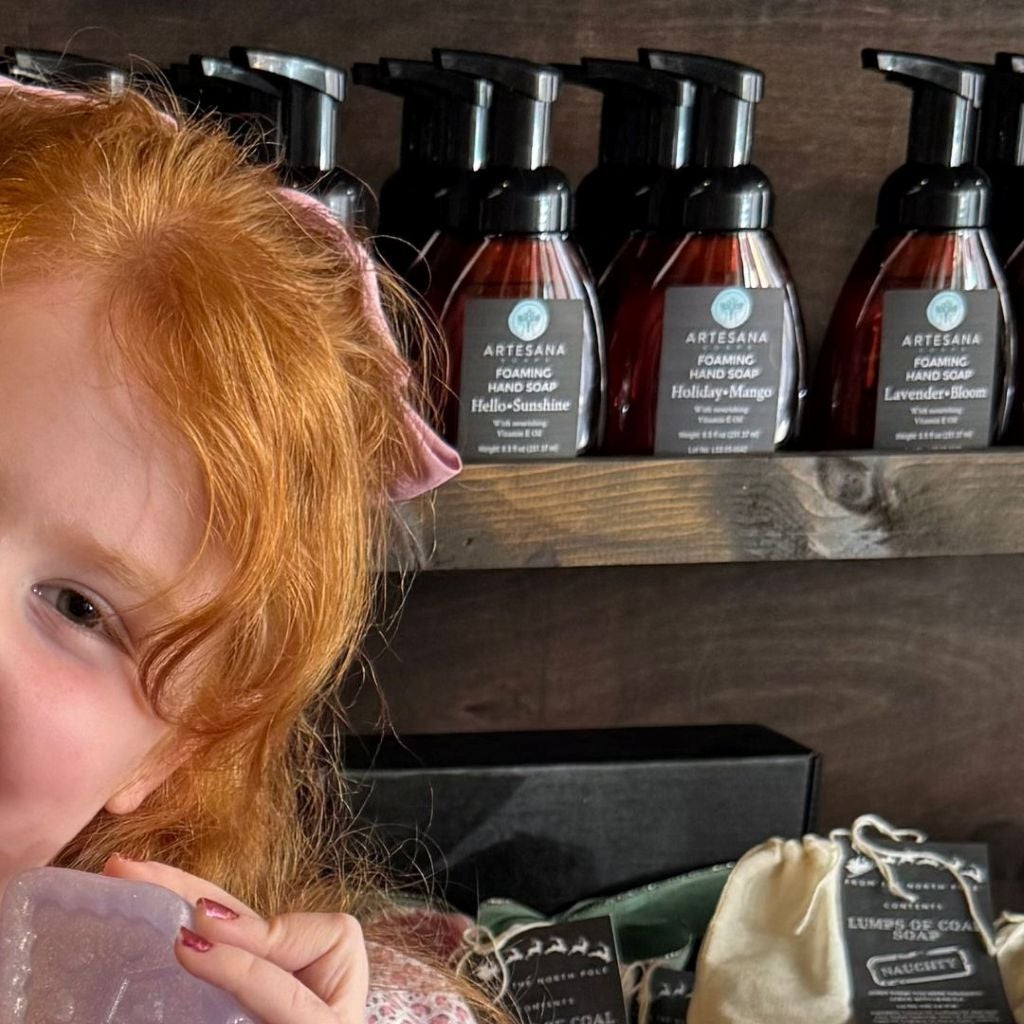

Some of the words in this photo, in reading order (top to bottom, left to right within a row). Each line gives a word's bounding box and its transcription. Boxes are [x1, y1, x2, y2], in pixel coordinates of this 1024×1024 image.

[685, 332, 768, 344] ARTESANA
[901, 333, 982, 347] ARTESANA
[483, 345, 566, 357] ARTESANA
[697, 354, 755, 366] FOAMING
[913, 355, 970, 369] FOAMING
[495, 367, 553, 379] FOAMING
[689, 368, 725, 380] HAND
[727, 368, 760, 379] SOAP
[905, 370, 941, 382] HAND
[942, 369, 974, 381] SOAP
[487, 382, 524, 393] HAND
[525, 381, 558, 393] SOAP
[883, 902, 944, 911] CONTENTS
[847, 916, 906, 931] LUMPS
[909, 919, 934, 931] OF
[937, 919, 975, 932] COA
[892, 930, 941, 942] SOAP
[579, 965, 608, 977] POLE
[880, 957, 957, 978] NAUGHTY
[524, 997, 574, 1012] ONTENTS
